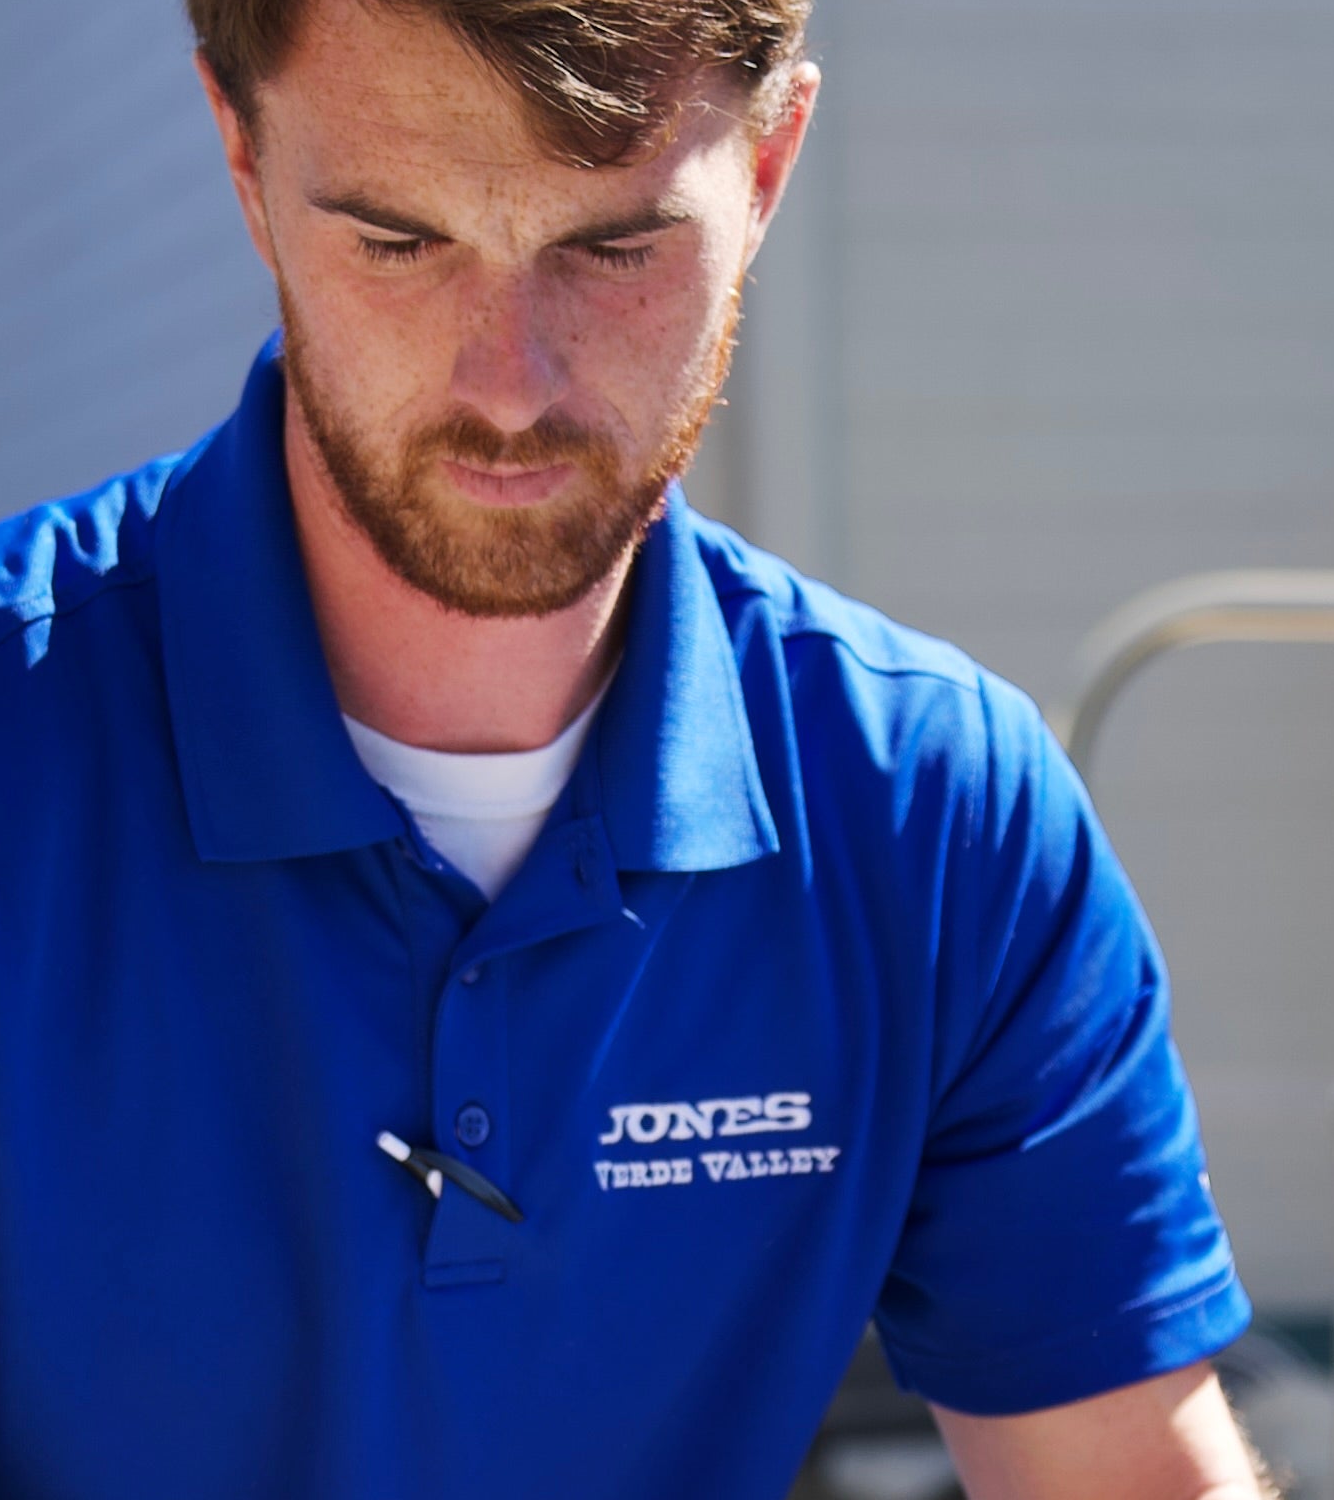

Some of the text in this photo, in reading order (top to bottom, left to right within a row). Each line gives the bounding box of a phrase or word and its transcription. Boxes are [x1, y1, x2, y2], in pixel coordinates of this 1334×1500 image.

[599, 1092, 811, 1144] JONES
[594, 1146, 840, 1191] VERDE VALLEY
